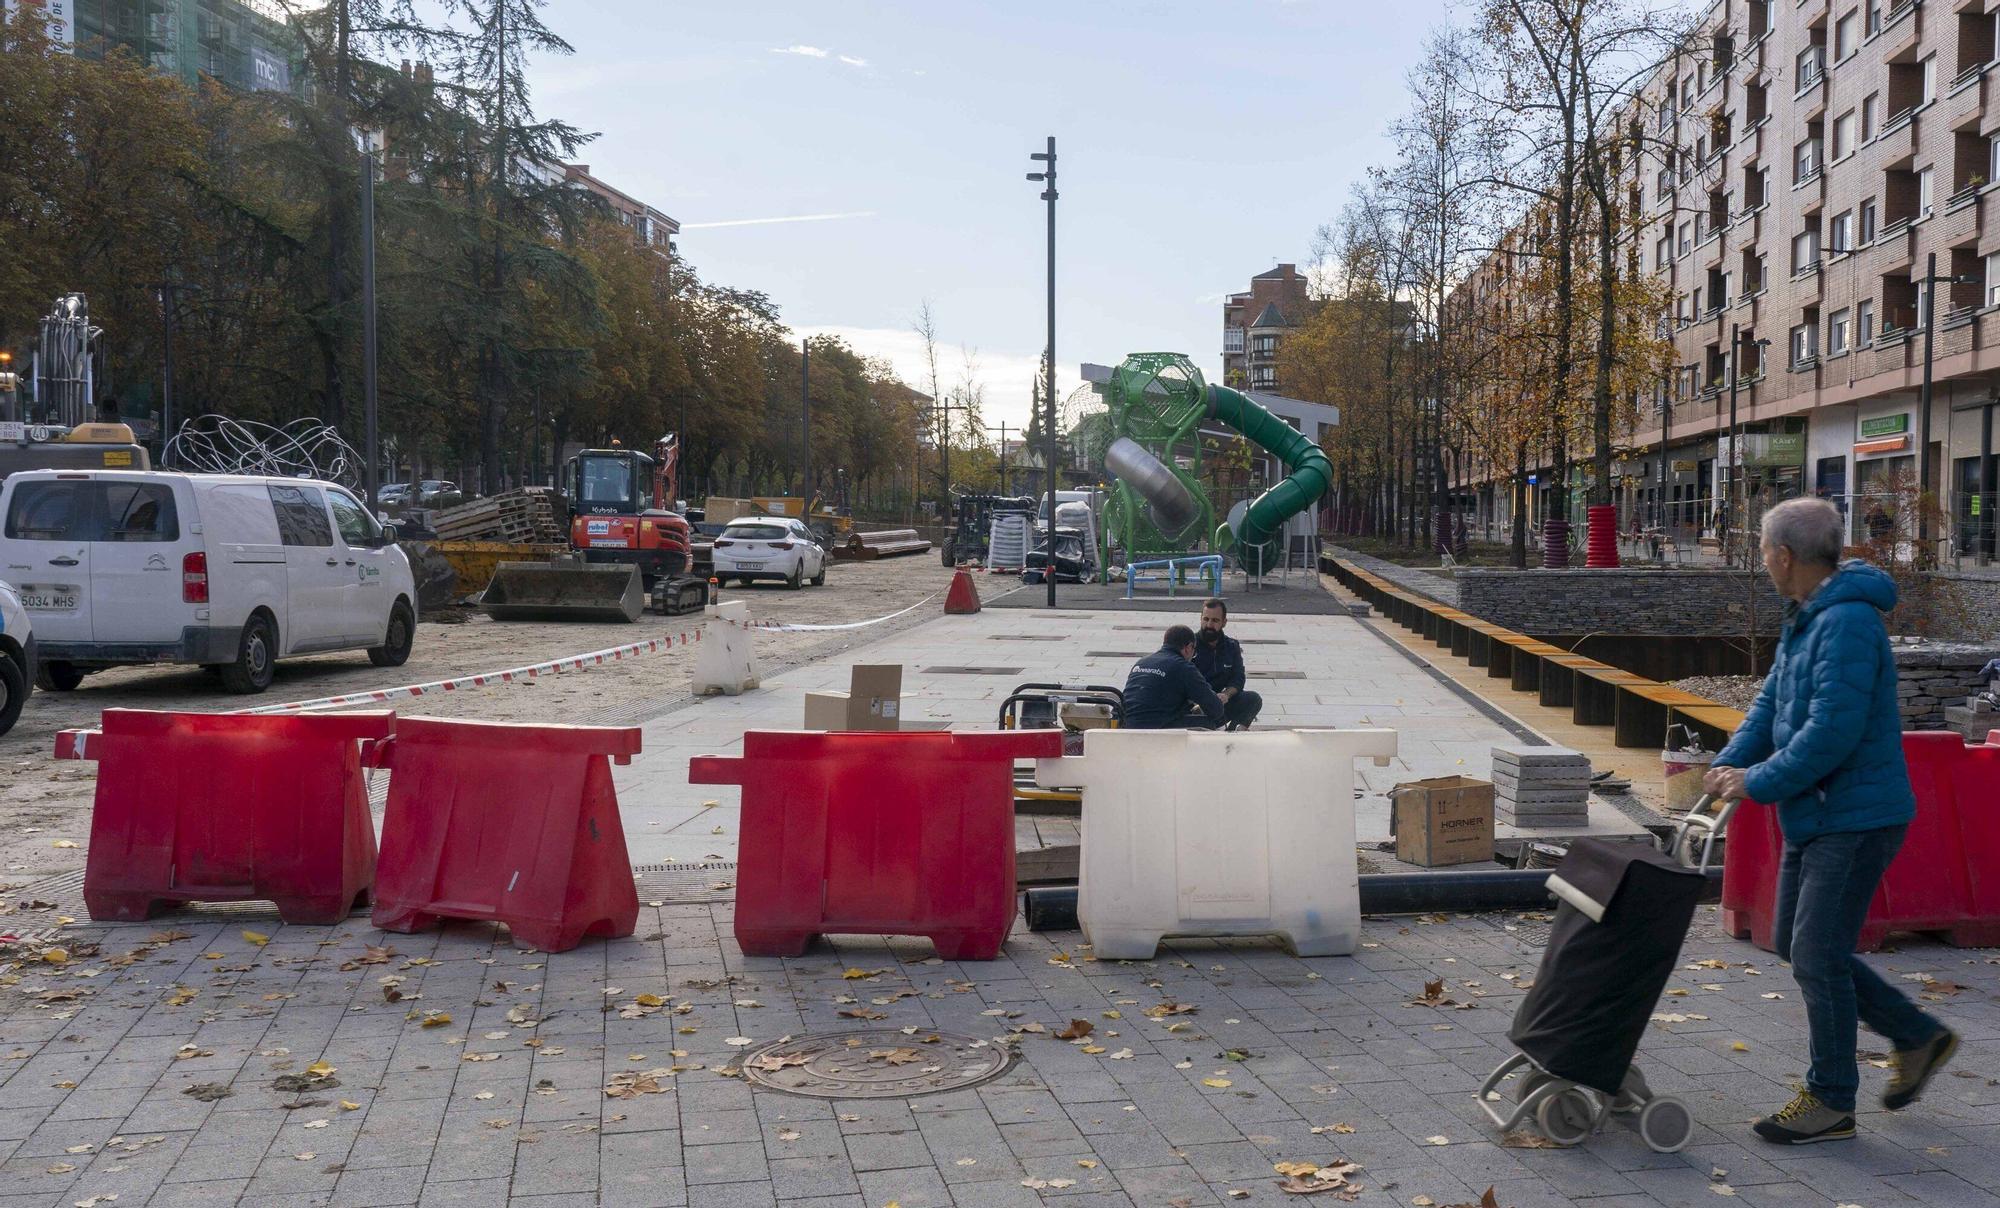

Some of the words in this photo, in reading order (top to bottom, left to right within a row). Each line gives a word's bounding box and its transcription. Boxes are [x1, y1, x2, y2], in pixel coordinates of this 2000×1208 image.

[33, 426, 47, 439] 40
[592, 506, 618, 514] Kubota
[21, 596, 49, 607] 5034
[52, 596, 74, 607] MHS
